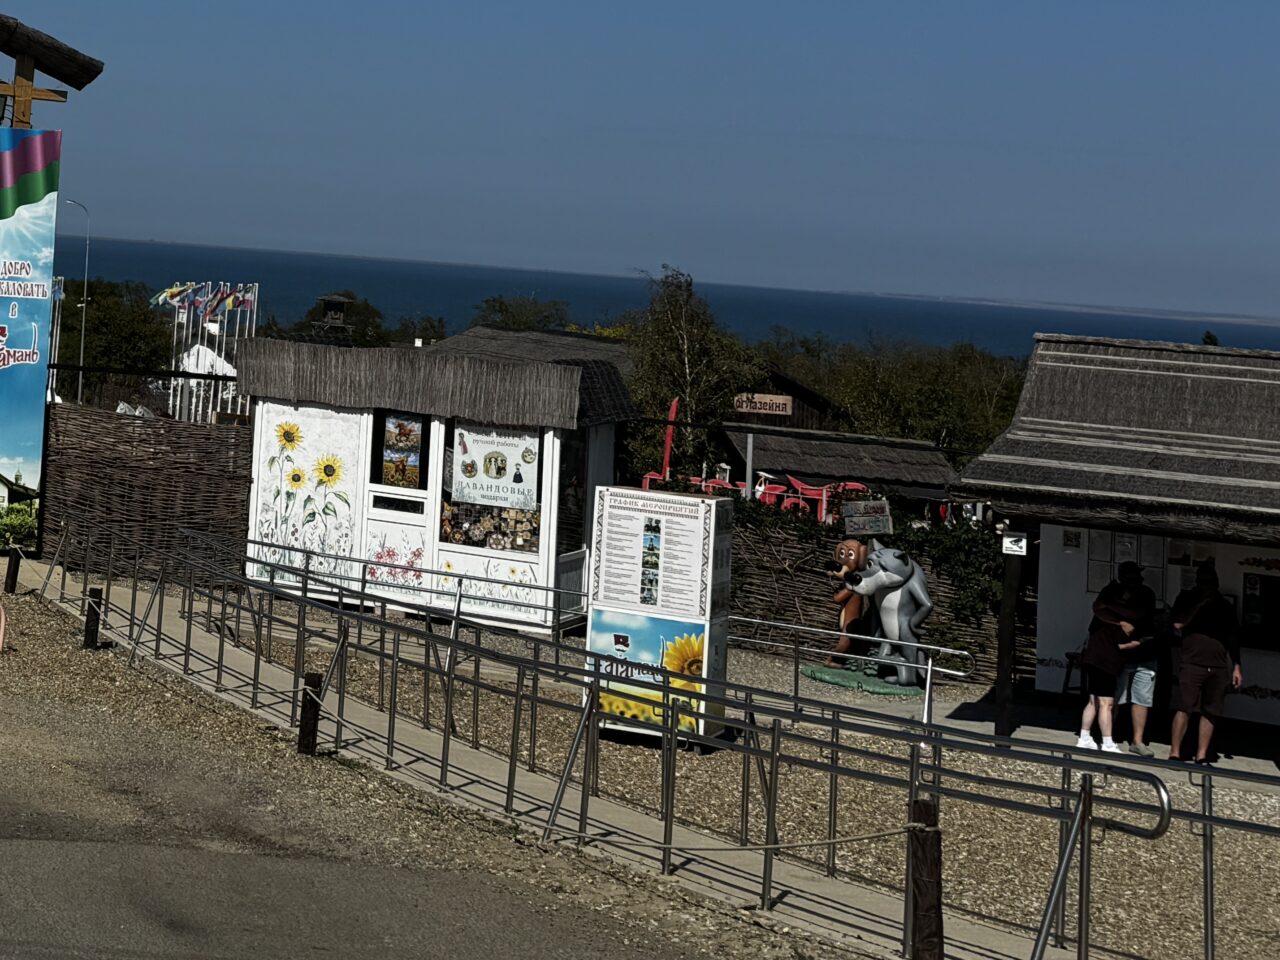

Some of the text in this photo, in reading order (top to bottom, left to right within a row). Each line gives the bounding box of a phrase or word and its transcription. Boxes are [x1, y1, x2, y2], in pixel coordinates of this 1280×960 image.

[0, 261, 31, 278] ДОБРО
[458, 481, 534, 497] ЛАВАНДОВЫЕ
[609, 498, 699, 514] ГРАФИК МЕРОПРИЯТИЙ
